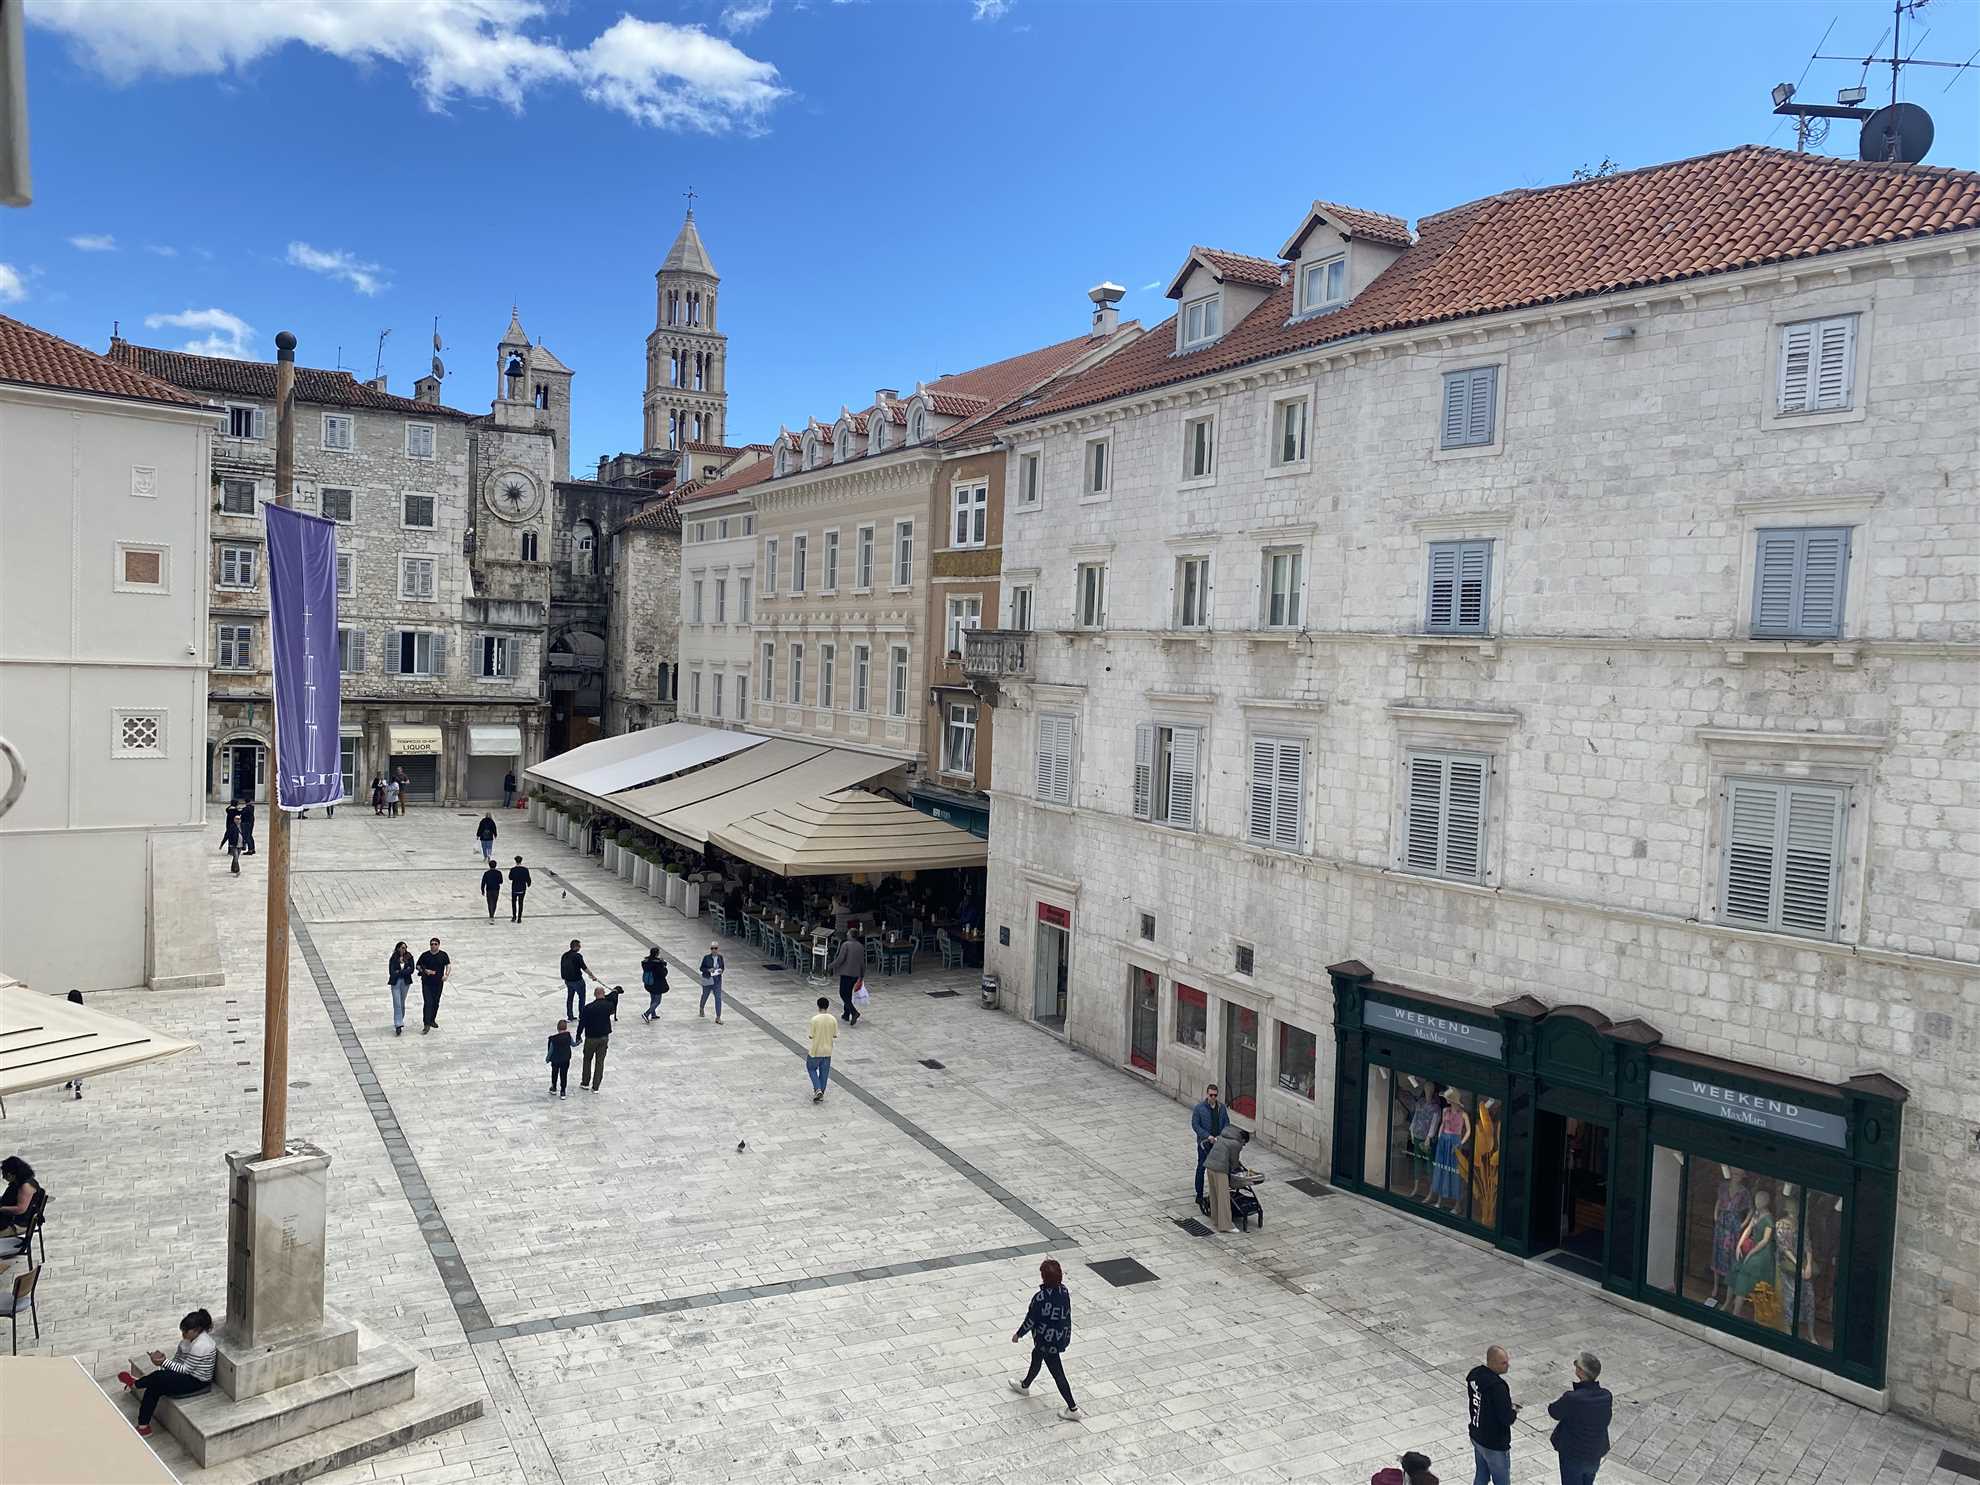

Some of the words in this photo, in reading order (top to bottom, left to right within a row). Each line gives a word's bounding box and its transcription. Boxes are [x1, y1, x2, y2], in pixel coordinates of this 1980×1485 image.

[1393, 1008, 1470, 1035] WEEKEND
[1414, 1028, 1448, 1044] MaxMara
[1691, 1081, 1799, 1117] WEEKEND
[1720, 1106, 1767, 1128] MaxMara
